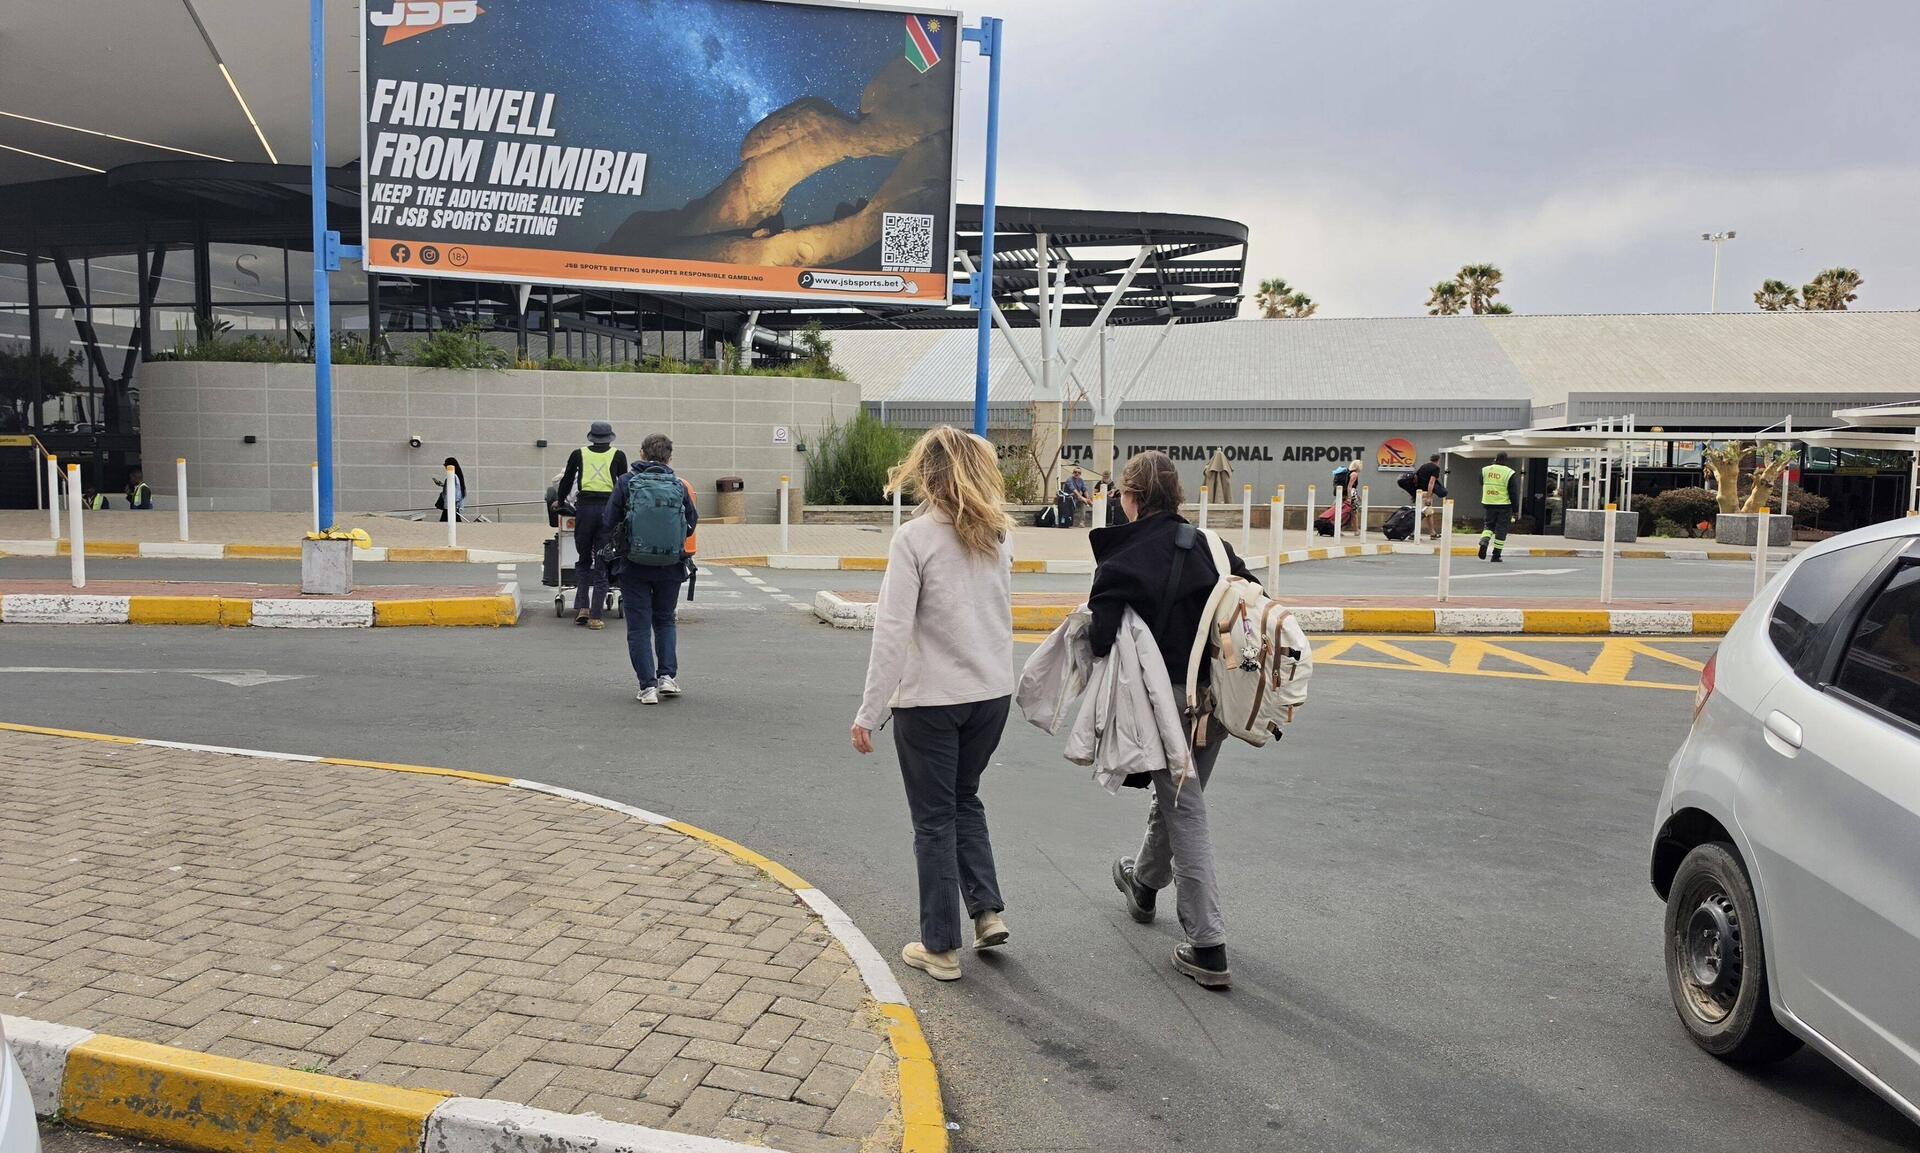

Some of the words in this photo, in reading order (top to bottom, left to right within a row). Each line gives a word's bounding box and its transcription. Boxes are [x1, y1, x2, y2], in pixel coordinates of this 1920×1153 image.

[370, 0, 478, 27] JSB
[369, 79, 556, 137] FAREWELL
[369, 131, 484, 183] FROM
[488, 141, 648, 196] NAMIBIA
[371, 183, 413, 204] KEEP
[415, 186, 446, 206] THE
[447, 188, 539, 213] ADVENTURE
[539, 195, 585, 216] ALIVE
[371, 205, 394, 225] AT
[396, 207, 429, 228] JSB
[431, 209, 493, 232] SPORTS
[494, 213, 559, 236] BETTING
[452, 252, 465, 261] 18+
[580, 263, 608, 271] SPORTS
[609, 265, 640, 273] BETTING
[641, 268, 678, 276] SUPPORTS
[679, 270, 727, 279] RESPONSIBLE
[728, 274, 764, 282] GAMBLING
[814, 277, 899, 288] www.jsbsports.bet
[1282, 446, 1365, 462] AIRPORT
